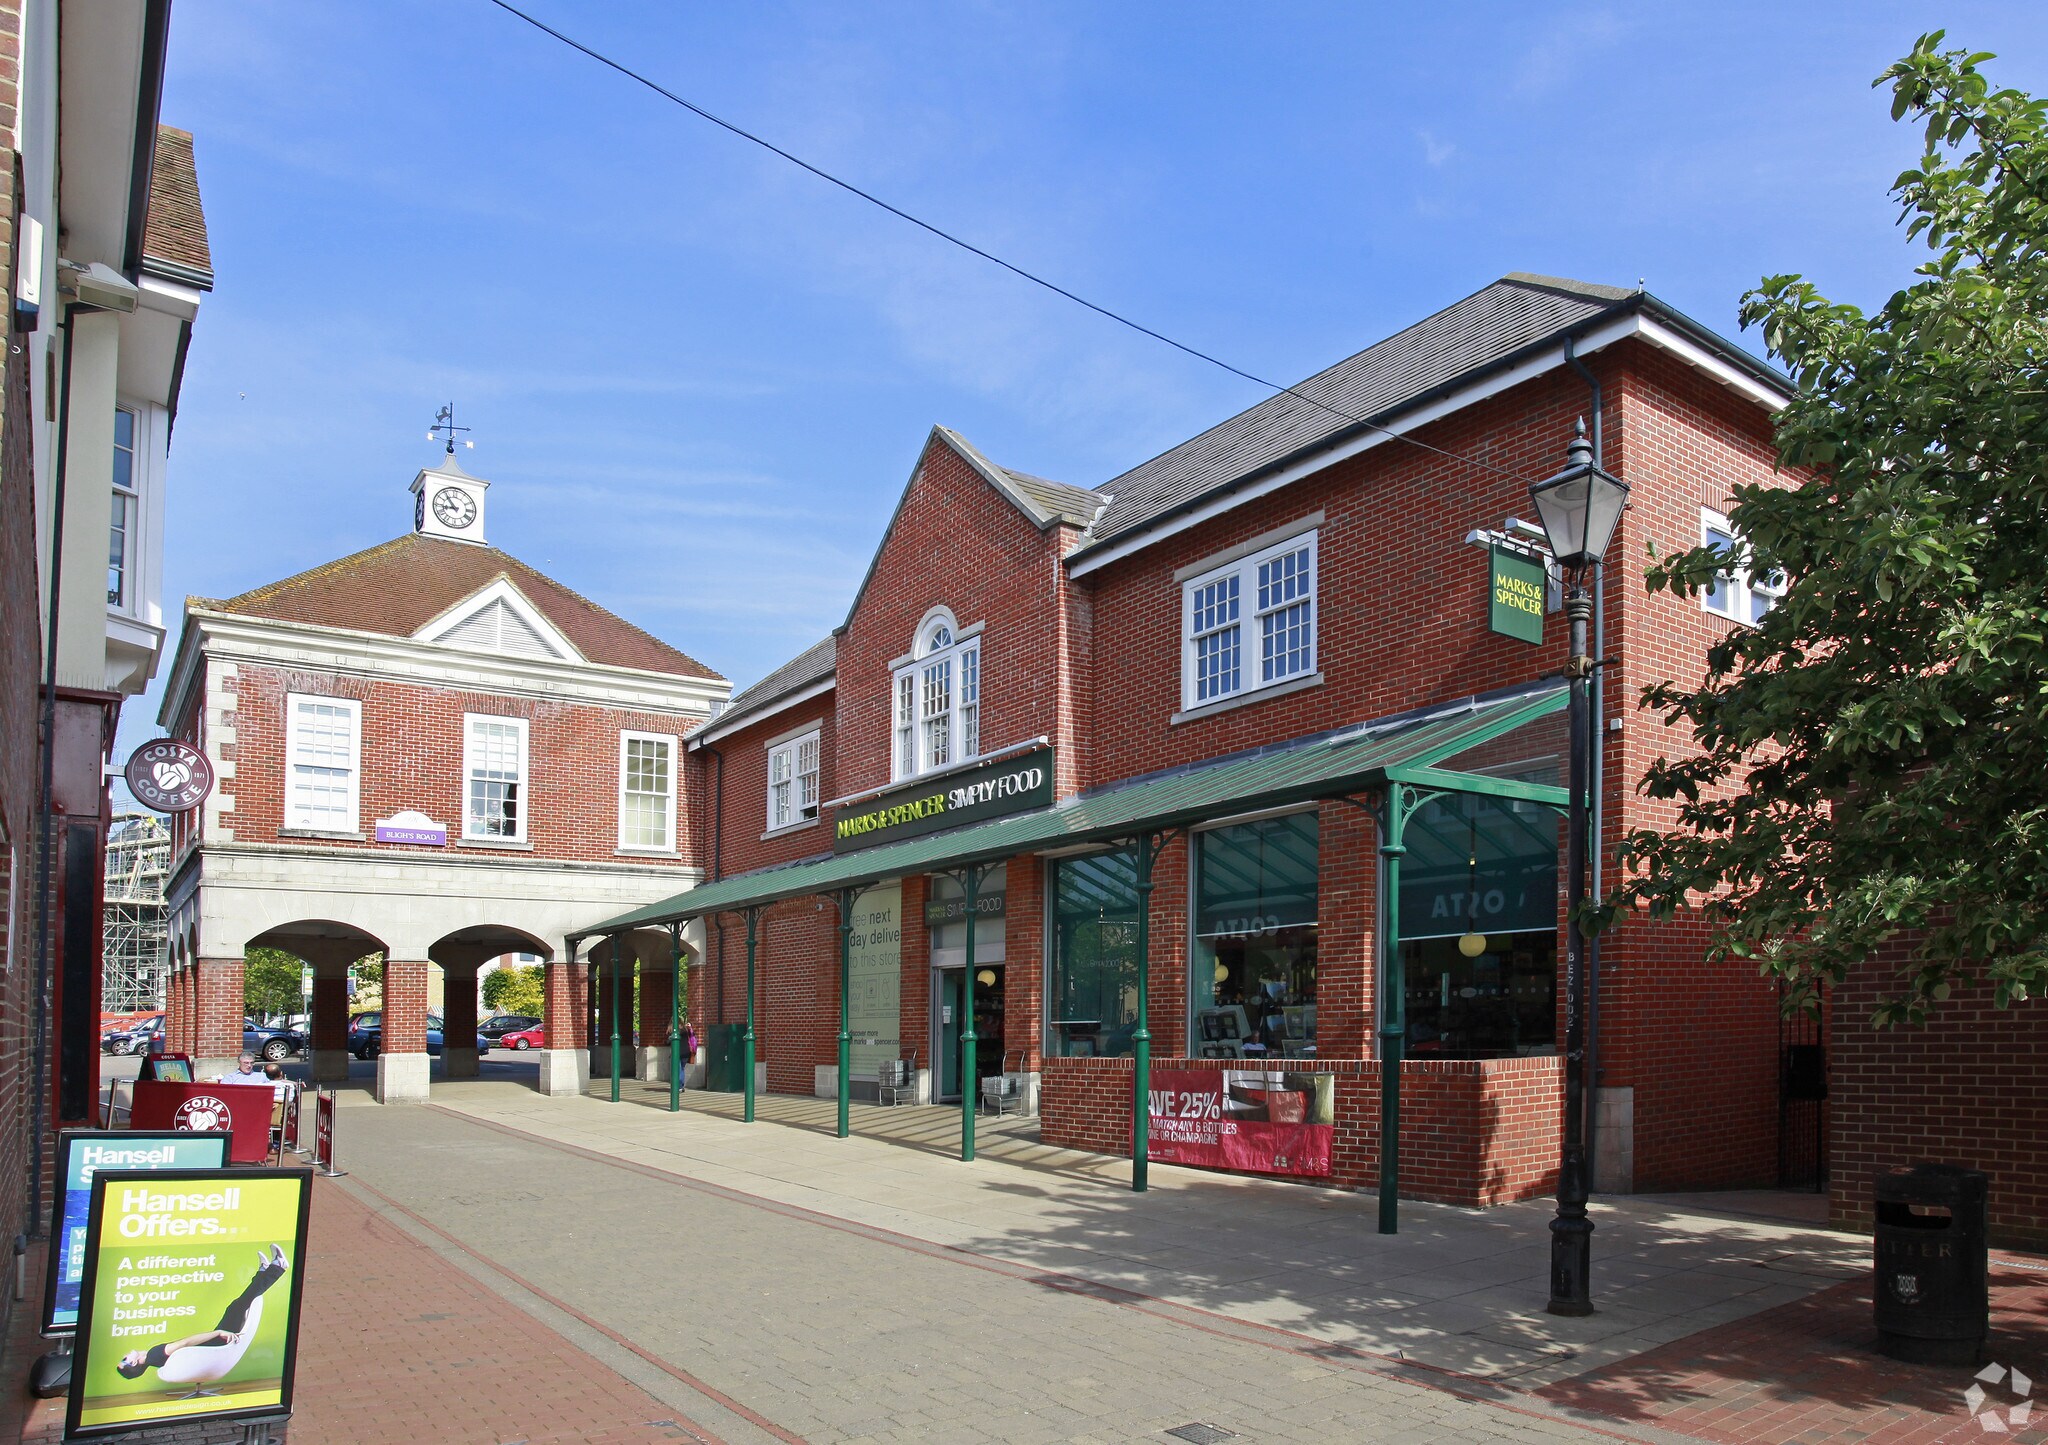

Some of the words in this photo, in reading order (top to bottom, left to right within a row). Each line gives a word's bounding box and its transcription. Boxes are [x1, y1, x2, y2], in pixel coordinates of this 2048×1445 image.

[1496, 588, 1542, 616] SPENCER
[144, 746, 198, 767] COSTA
[138, 779, 202, 804] COFFEE
[888, 794, 945, 826] SPENCER
[948, 779, 996, 810] SIMPLY
[998, 768, 1042, 798] FOOD
[386, 831, 414, 840] BLIGH'S
[416, 833, 437, 841] ROAD
[947, 902, 965, 917] SIMP
[977, 897, 1002, 912] FOOD
[850, 912, 867, 927] ree
[870, 908, 891, 924] next
[849, 931, 867, 949] day
[870, 928, 900, 944] delive
[849, 955, 858, 968] to
[861, 951, 876, 967] this
[160, 1062, 182, 1072] HELLO
[184, 1098, 224, 1114] COSTA
[1148, 1090, 1176, 1117] AVE
[1180, 1091, 1220, 1120] 25%
[1153, 1118, 1177, 1131] MATCH
[1178, 1120, 1194, 1132] ANY
[1196, 1121, 1201, 1132] 6
[1203, 1121, 1237, 1135] BOTTLES
[1161, 1130, 1170, 1142] OR
[1171, 1131, 1217, 1145] CHAMPAGNE
[82, 1145, 176, 1164] Hansell
[122, 1187, 240, 1213] Hansell
[118, 1257, 132, 1270] A
[137, 1254, 216, 1269] different
[116, 1270, 224, 1289] perspective
[115, 1291, 134, 1303] to
[138, 1290, 180, 1305] your
[113, 1305, 196, 1320] business
[111, 1321, 167, 1337] brand
[135, 1399, 232, 1416] www.hanselldesign.co.uk
